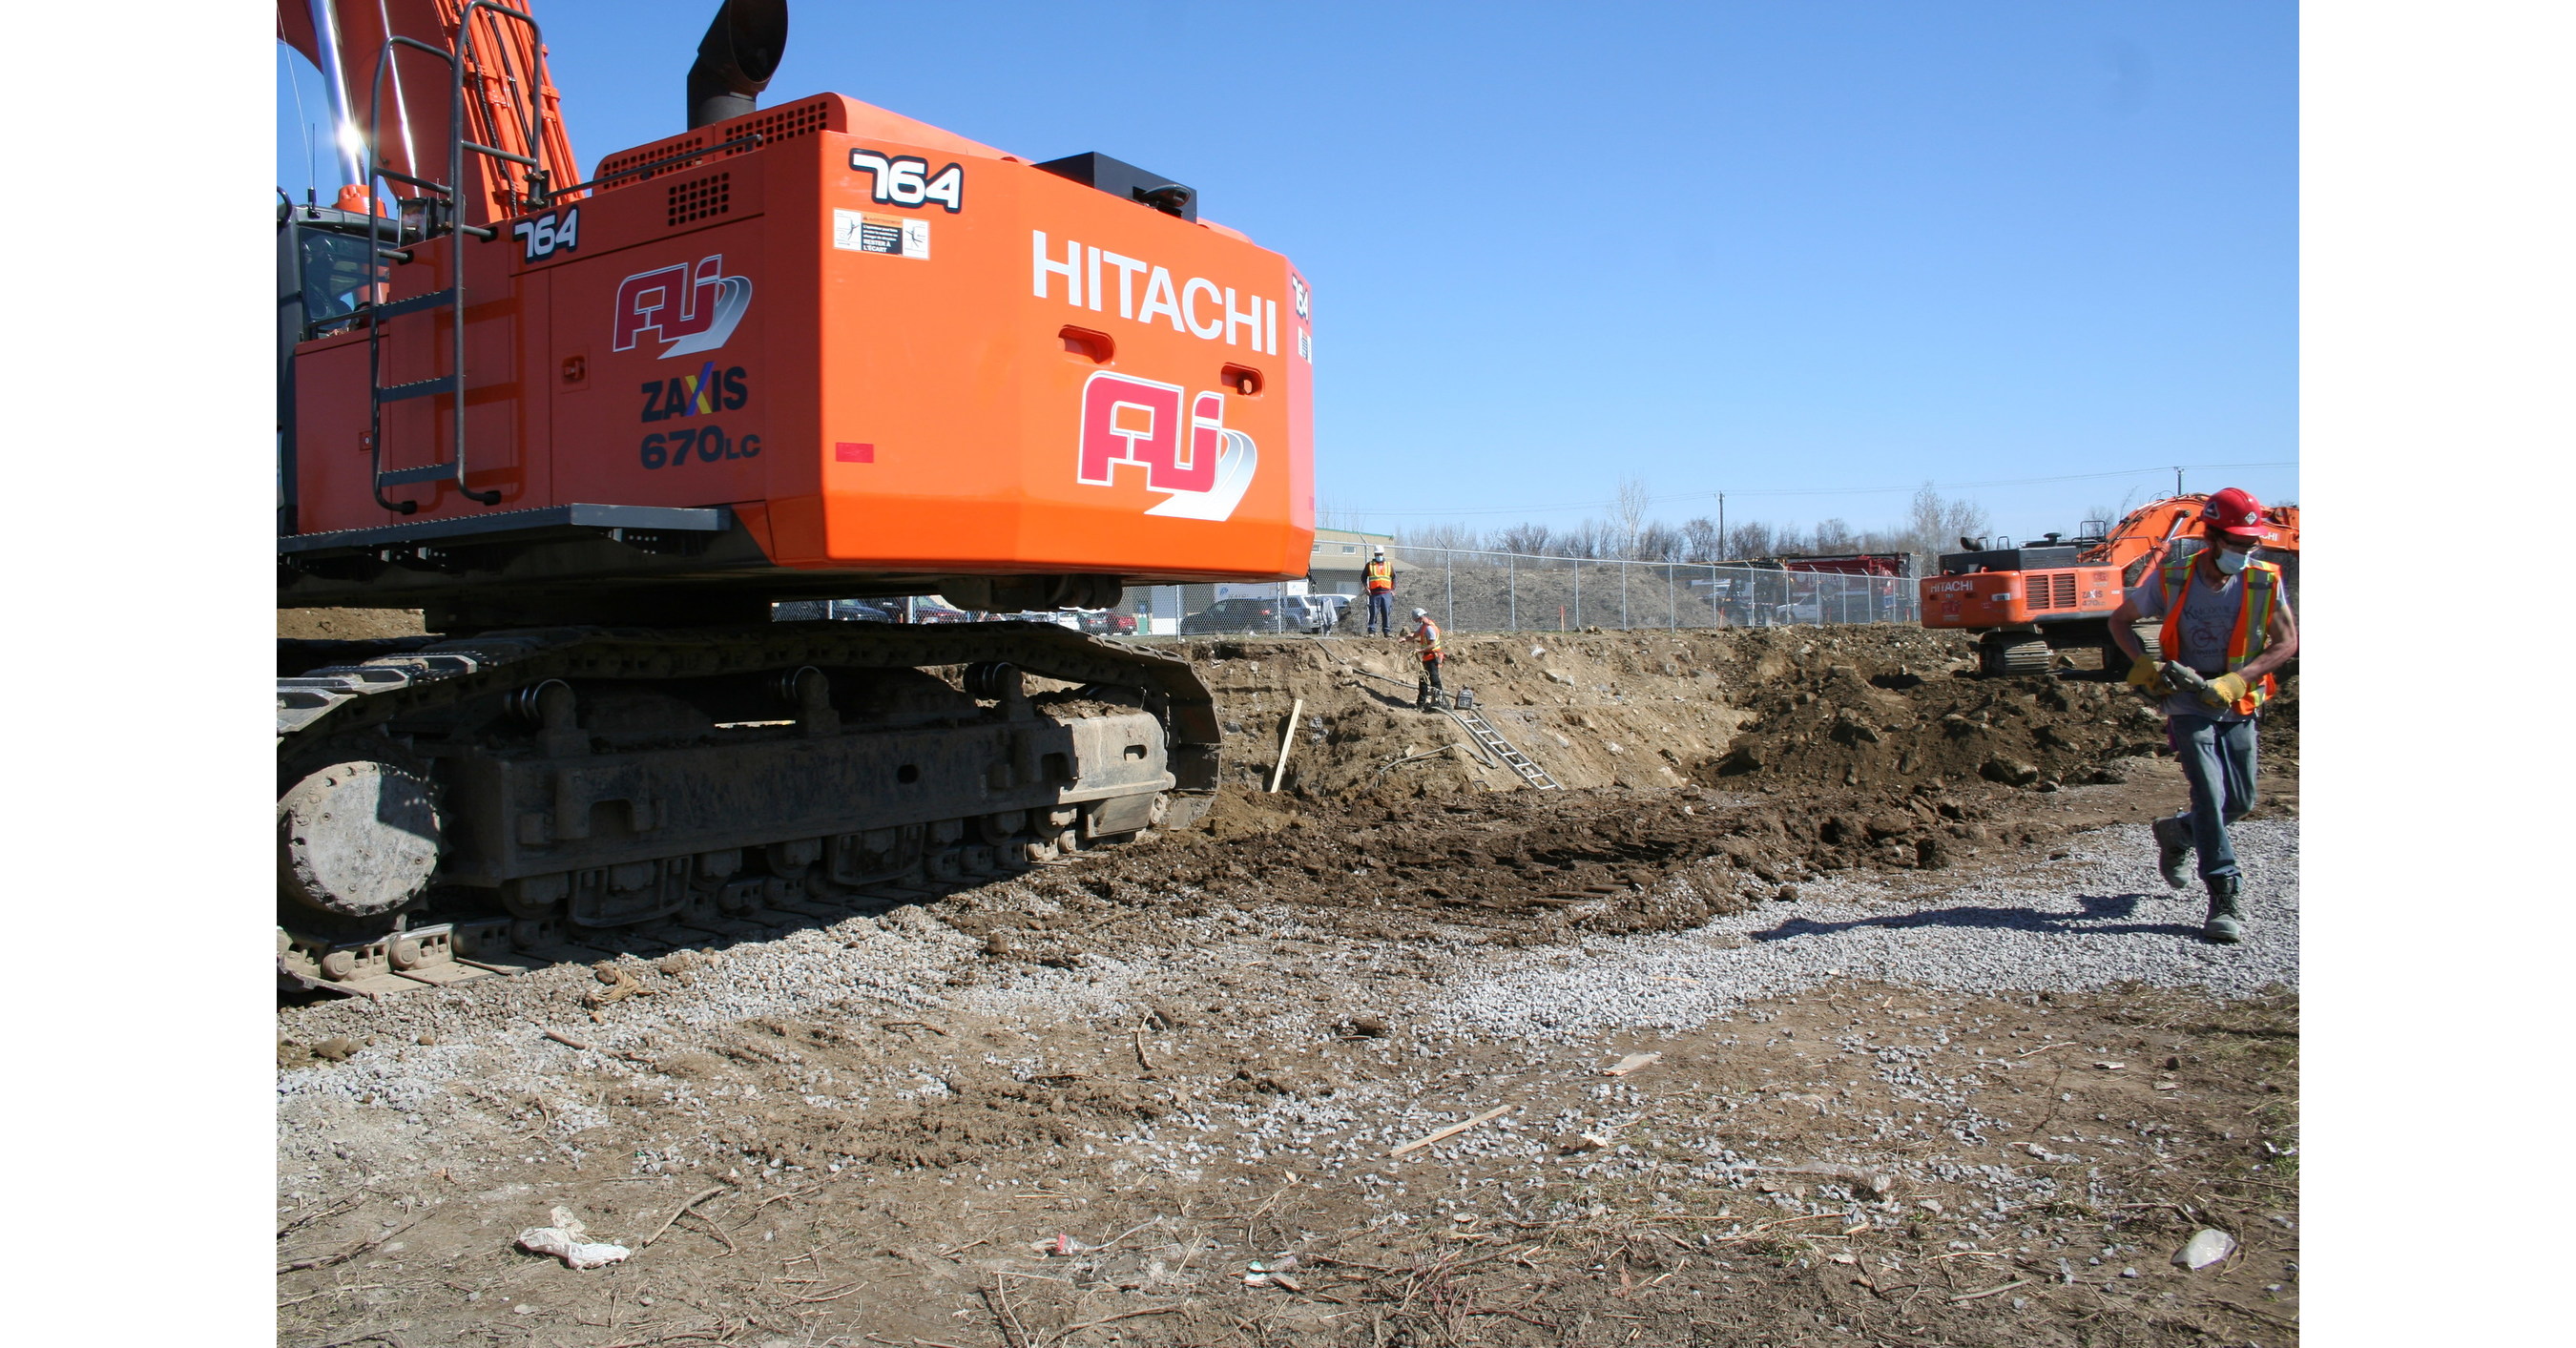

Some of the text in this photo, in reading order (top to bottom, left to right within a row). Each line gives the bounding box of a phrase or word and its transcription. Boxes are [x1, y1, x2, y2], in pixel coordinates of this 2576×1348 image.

[852, 153, 961, 210] 764
[513, 207, 578, 260] 764
[1032, 229, 1278, 356] HITACHI
[1292, 274, 1309, 322] 764
[641, 361, 749, 423] ZAXIS
[1930, 580, 1974, 592] HITACHI
[2082, 589, 2104, 599] ZAXIS
